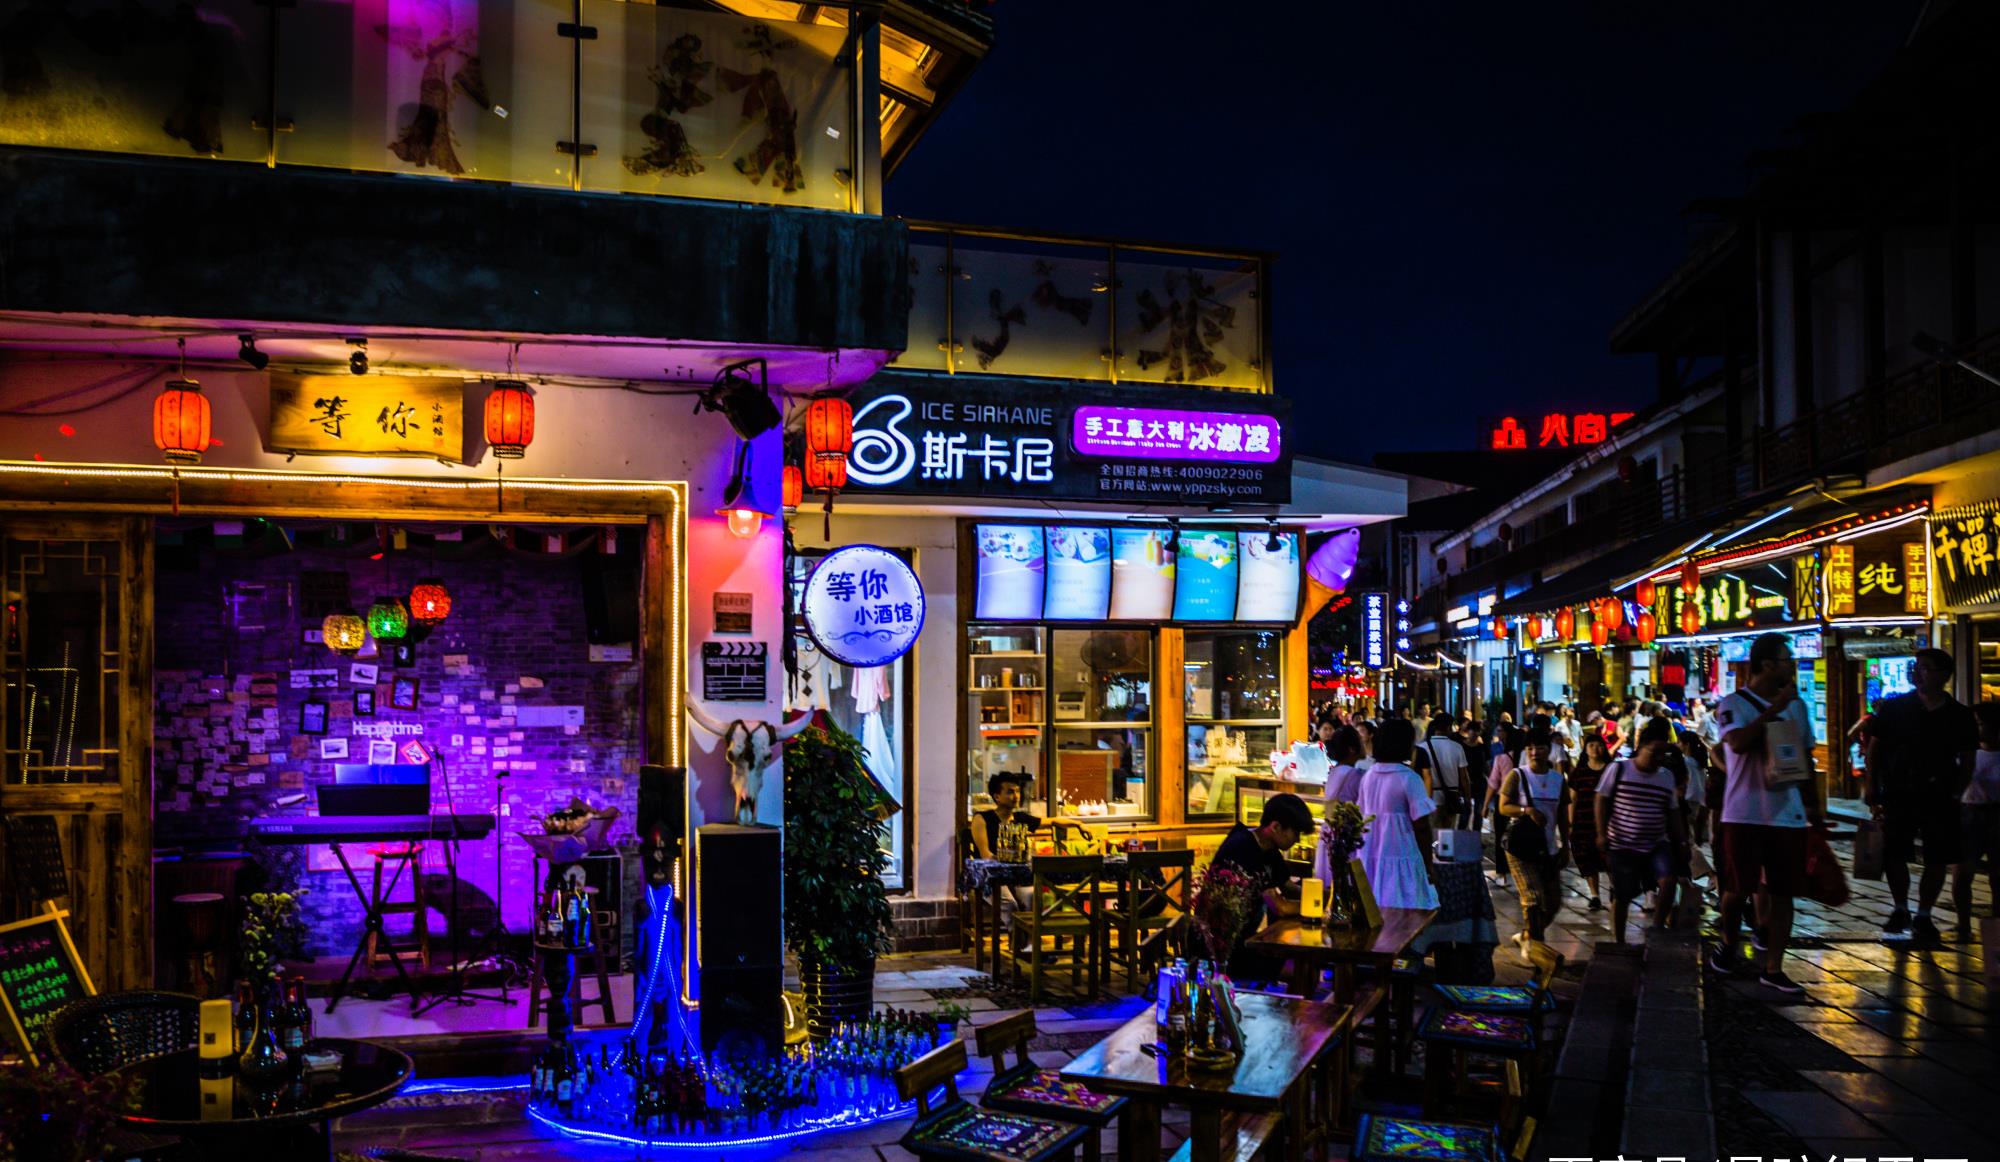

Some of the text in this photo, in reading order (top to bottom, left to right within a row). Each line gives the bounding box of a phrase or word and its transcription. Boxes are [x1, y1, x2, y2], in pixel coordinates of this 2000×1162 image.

[309, 395, 421, 439] 等你
[921, 402, 955, 421] ICE
[1084, 416, 1185, 441] 手工意大利
[1539, 412, 1636, 447] 火宫
[921, 430, 1054, 483] 斯卡尼
[826, 568, 889, 602] 等你
[1832, 548, 1853, 611] 土特产
[1858, 562, 1903, 596] 纯
[1908, 545, 1928, 610] 手工制作
[854, 602, 914, 626] 小酒馆
